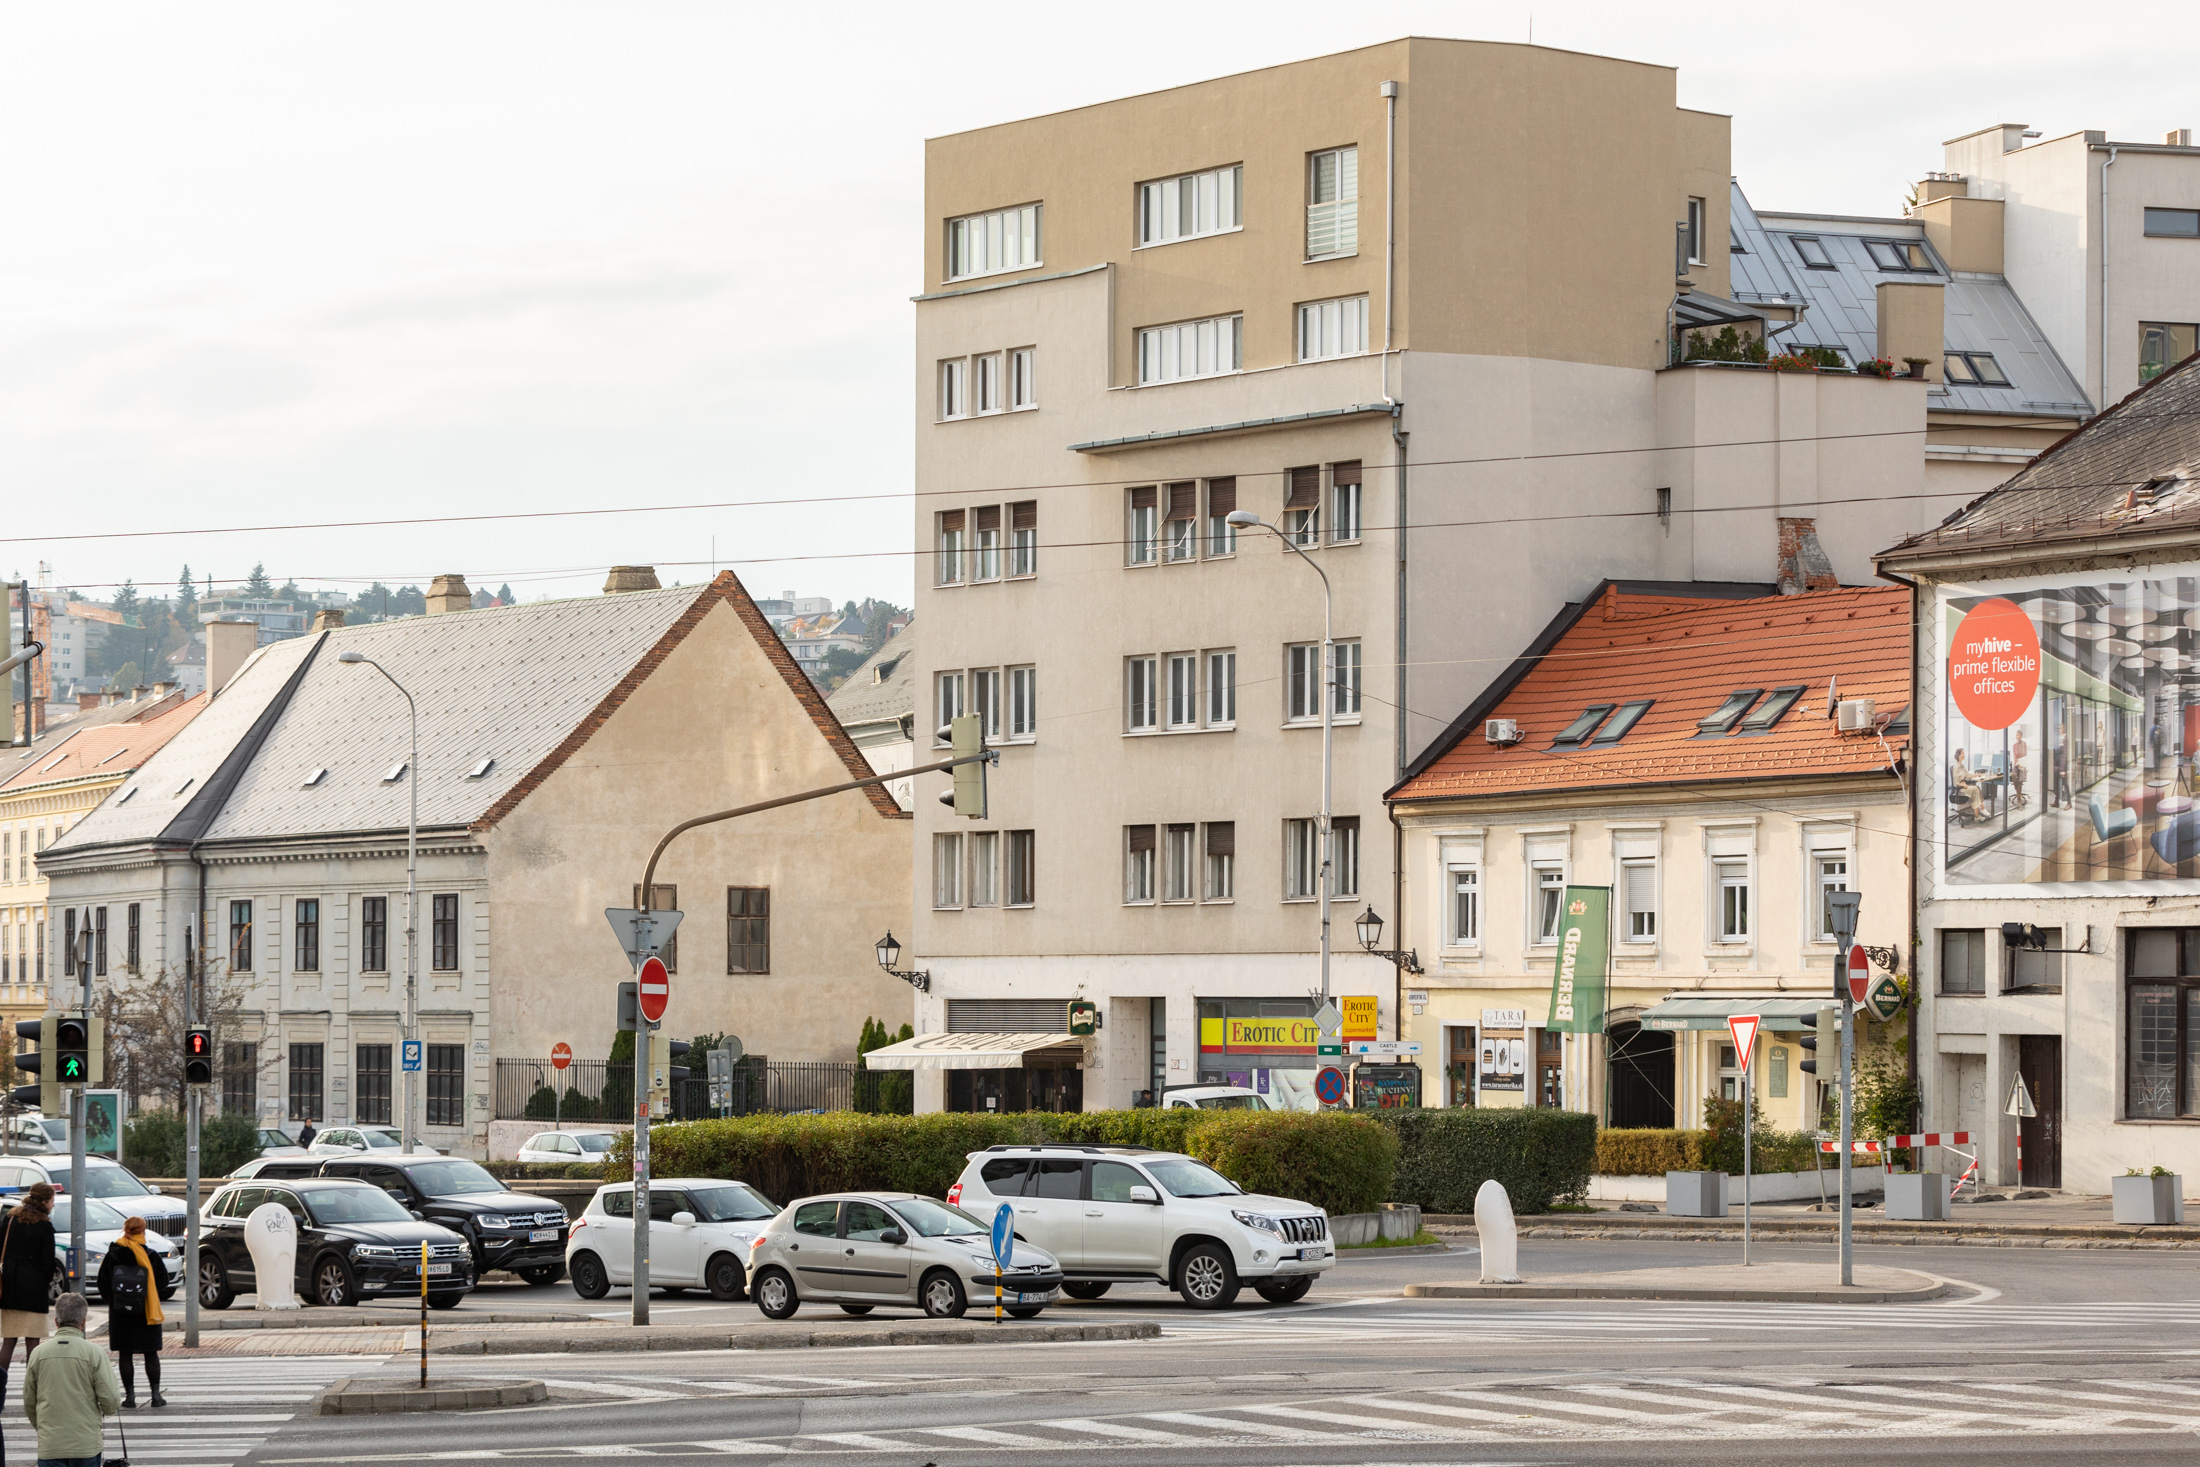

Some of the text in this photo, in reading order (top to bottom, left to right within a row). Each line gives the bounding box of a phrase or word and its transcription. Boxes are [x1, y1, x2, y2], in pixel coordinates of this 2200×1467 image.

[1966, 636, 2011, 658] myhive
[1953, 654, 2036, 680] prime flexible
[1973, 677, 2015, 694] offices
[1554, 927, 1582, 1022] BERNARD
[1875, 993, 1901, 1003] BERNARD
[1344, 999, 1376, 1011] EROTIC
[1349, 1012, 1370, 1023] CITY
[1493, 1010, 1522, 1021] TARA
[1344, 1026, 1375, 1034] supermarket
[1660, 1020, 1688, 1028] BERNARD
[1231, 1022, 1320, 1043] EROTIC CIT
